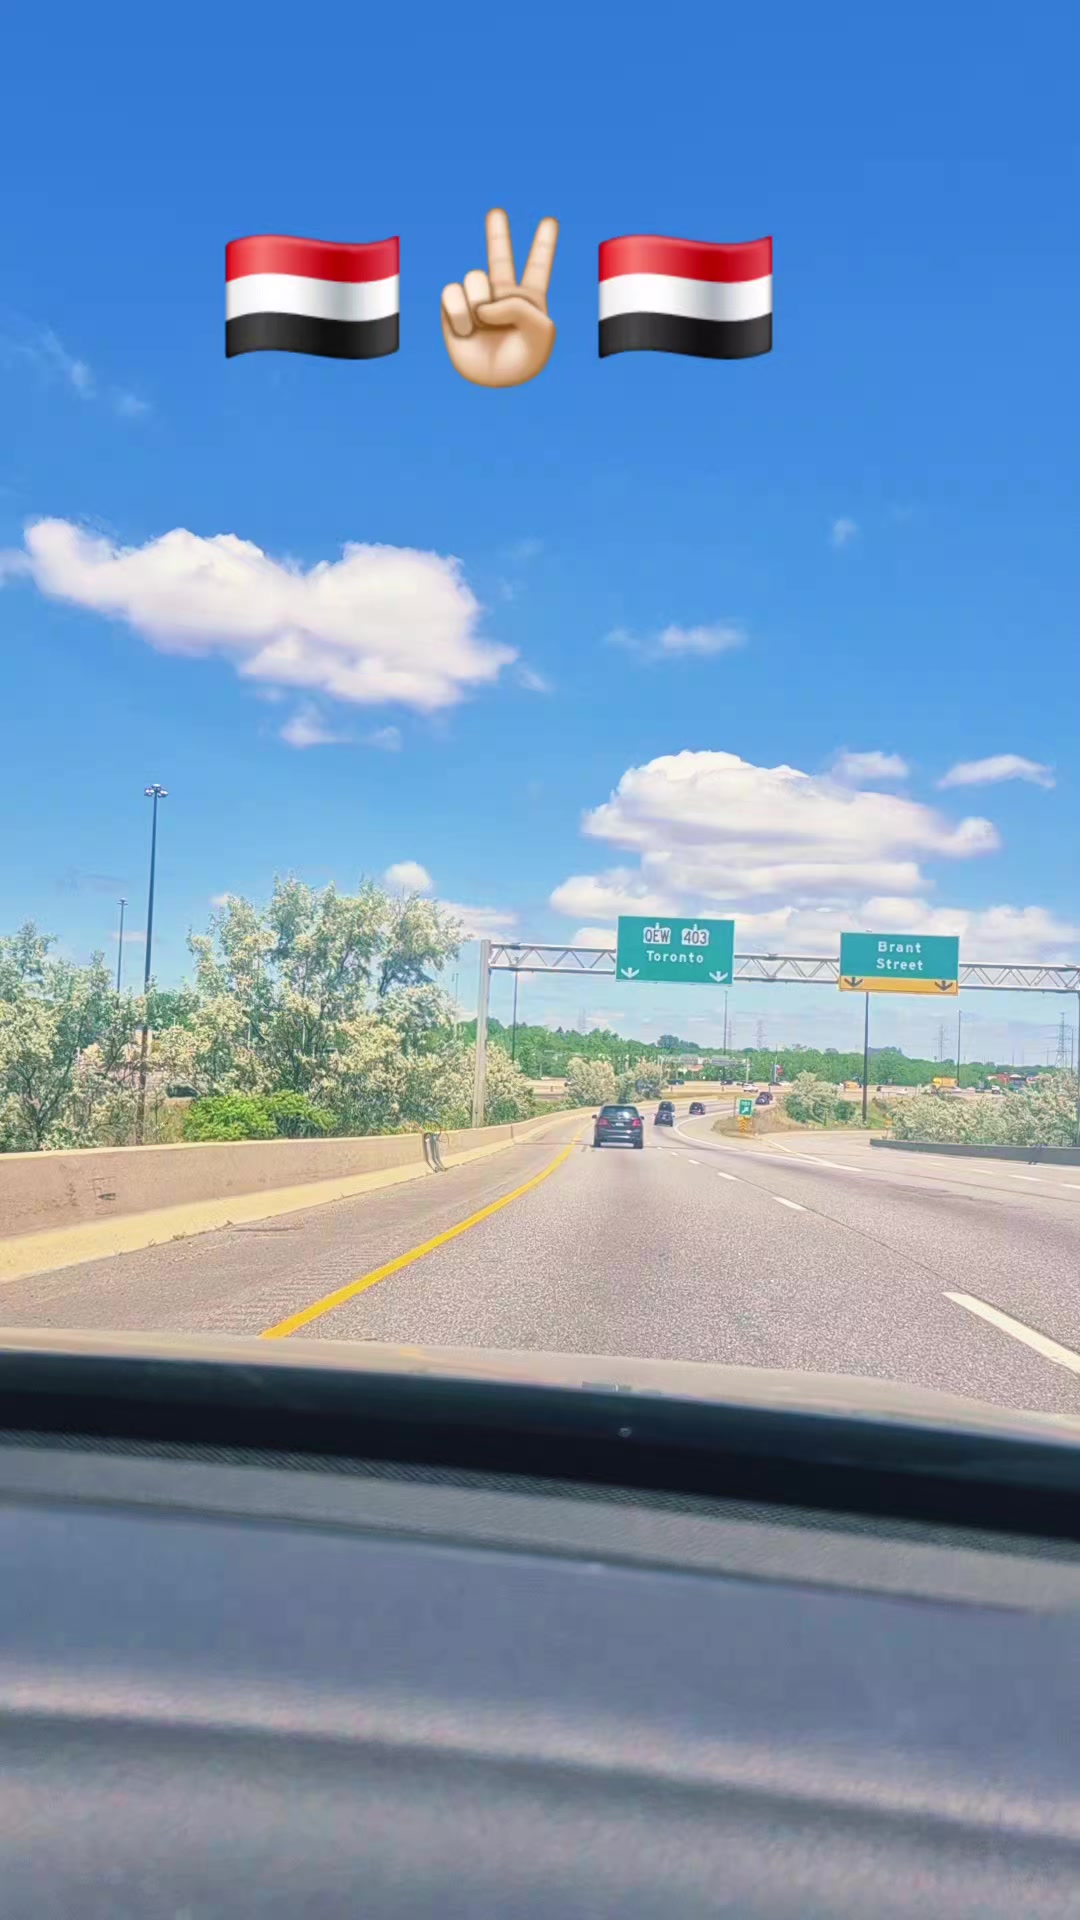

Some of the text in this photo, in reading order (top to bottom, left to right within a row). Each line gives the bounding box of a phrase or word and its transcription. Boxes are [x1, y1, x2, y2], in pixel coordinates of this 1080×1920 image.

[644, 929, 707, 945] QEW 403
[877, 941, 922, 954] Brant
[646, 950, 704, 964] Toronto
[876, 957, 923, 971] Street
